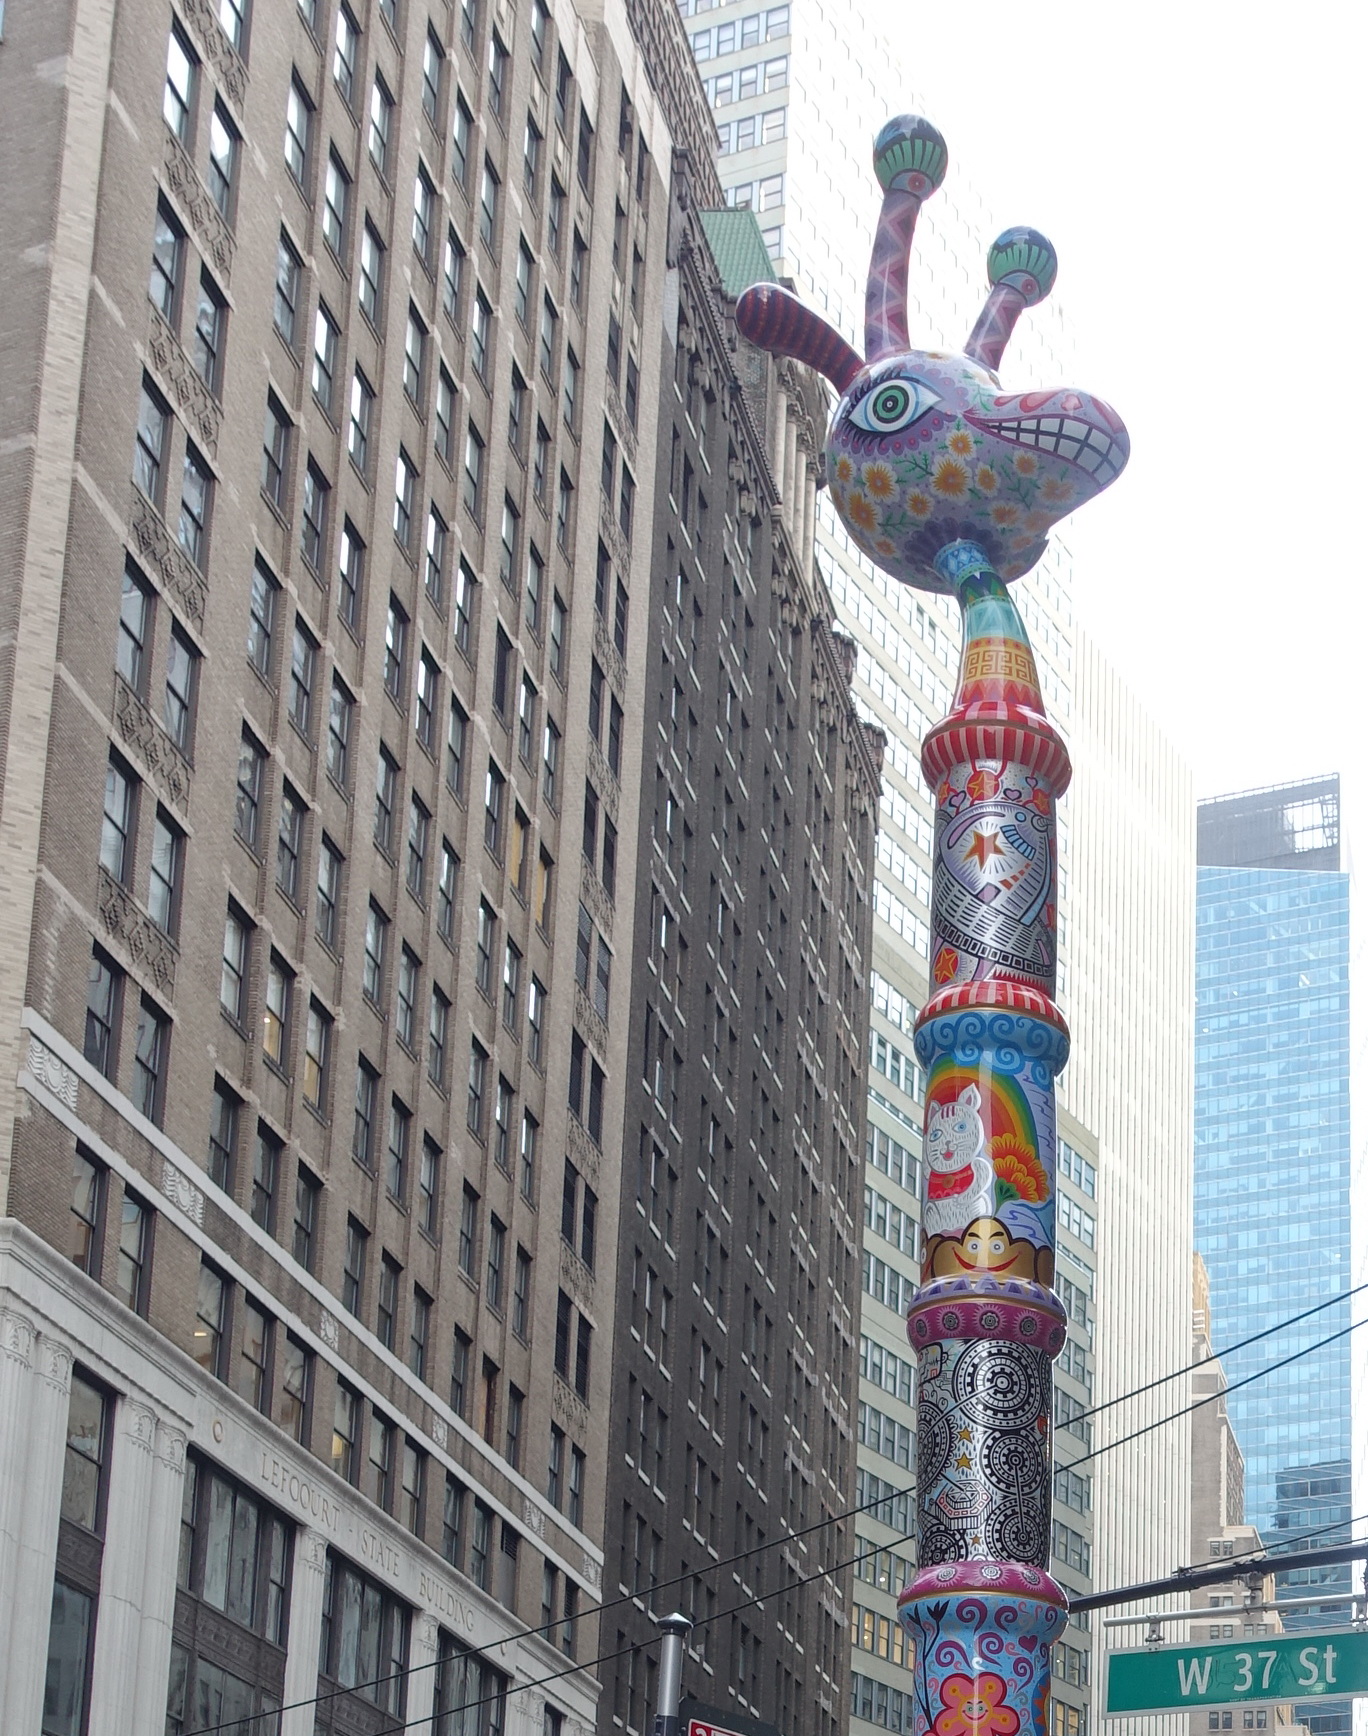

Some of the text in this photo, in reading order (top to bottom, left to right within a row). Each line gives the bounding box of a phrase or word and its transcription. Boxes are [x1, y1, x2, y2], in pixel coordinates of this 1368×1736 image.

[261, 1452, 340, 1532] LEFCOURT
[361, 1529, 400, 1577] STATE
[419, 1572, 474, 1632] BUILDING
[1177, 1644, 1337, 1696] W 37 St
